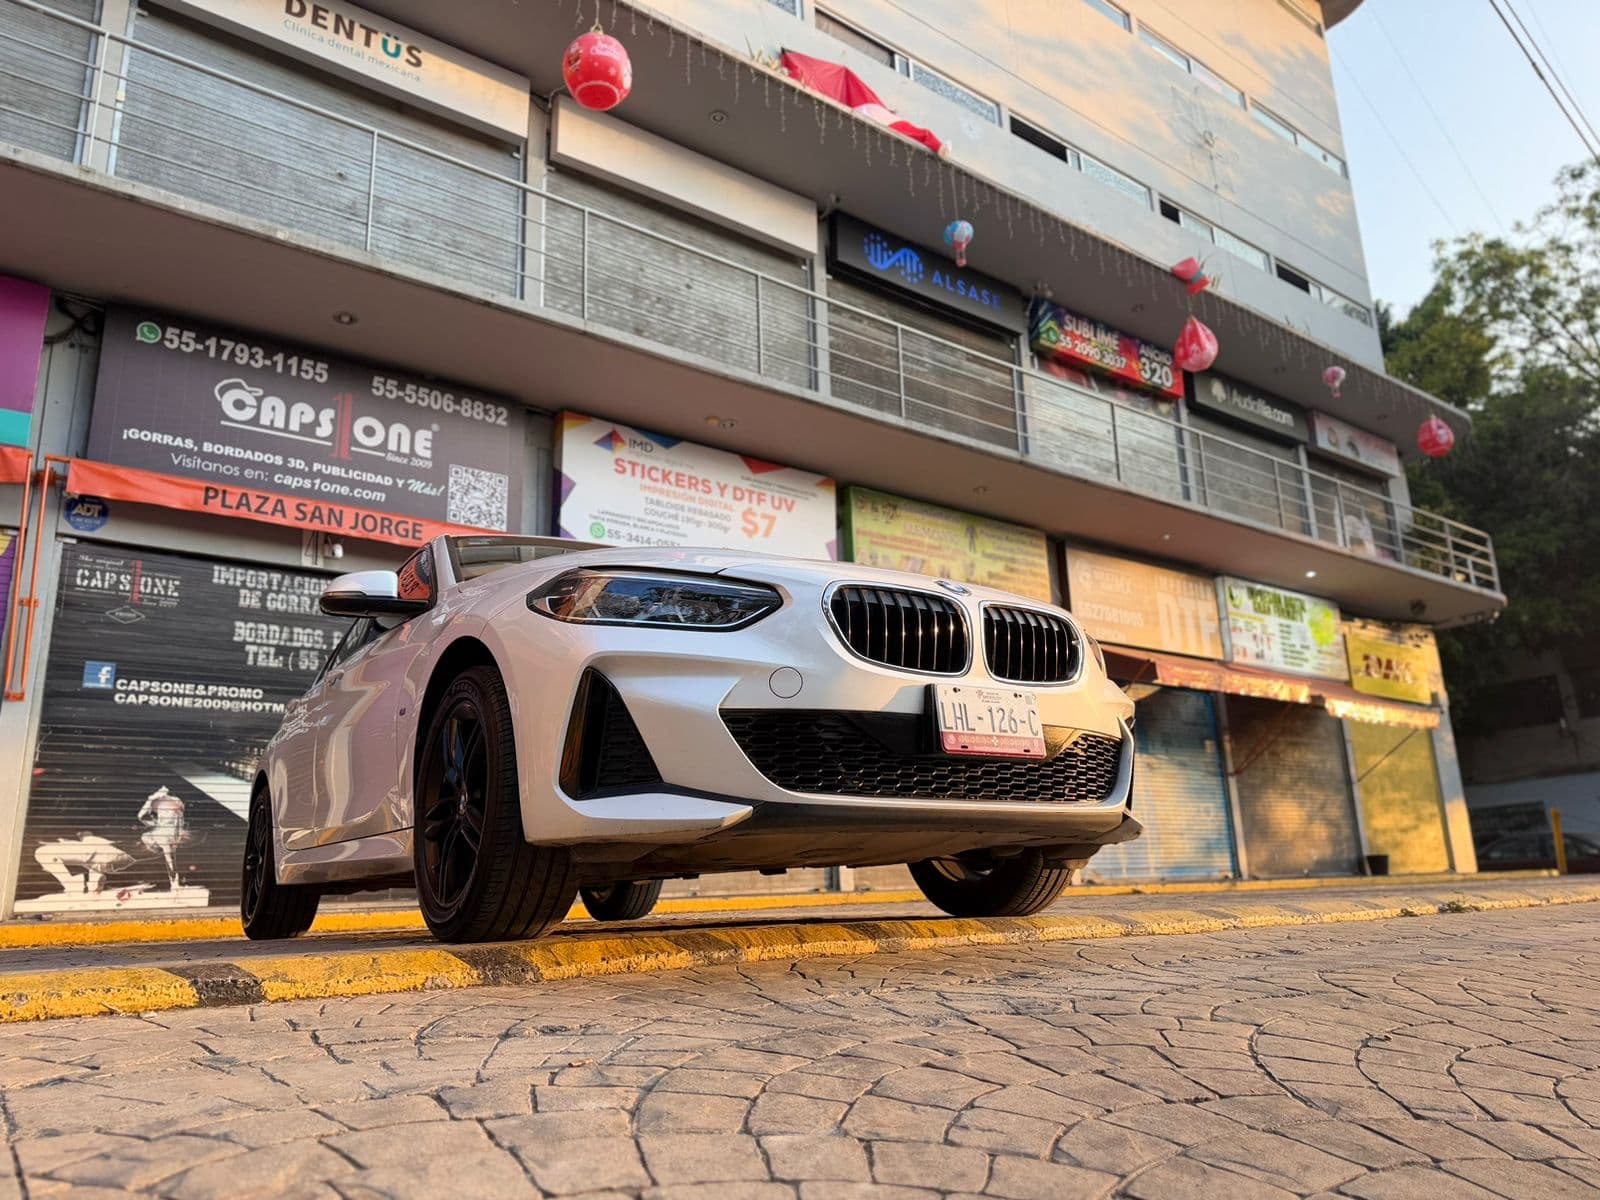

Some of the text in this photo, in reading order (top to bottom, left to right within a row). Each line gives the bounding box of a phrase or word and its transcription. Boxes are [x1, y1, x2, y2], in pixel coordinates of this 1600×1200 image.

[285, 0, 422, 68] DENTÜS
[328, 37, 365, 60] dental
[368, 54, 421, 81] mexicana
[163, 326, 329, 383] 55-1793-1155
[1140, 357, 1173, 388] 320
[371, 375, 508, 427] 55-5506-8832
[628, 437, 654, 453] IMD
[203, 441, 283, 466] BORDADOS
[287, 457, 309, 472] 3D,
[312, 462, 393, 487] PUBLICIDAD
[396, 478, 406, 488] Y
[244, 467, 269, 482] en:
[274, 473, 386, 502] caps1one.com
[614, 457, 712, 495] STICKERS
[715, 480, 729, 498] Y
[732, 485, 767, 506] DTF
[770, 495, 796, 513] UV
[73, 503, 102, 518] ADT
[203, 486, 424, 541] PLAZA SAN JORGE
[740, 506, 777, 539] $7
[238, 589, 262, 608] DE
[1156, 591, 1218, 658] DTF
[245, 644, 283, 668] TEL:
[114, 693, 287, 713] CAPSONE2009@HOTM
[116, 679, 264, 699] CAPSONE&PROMO
[939, 701, 1039, 737] LHL-126-C
